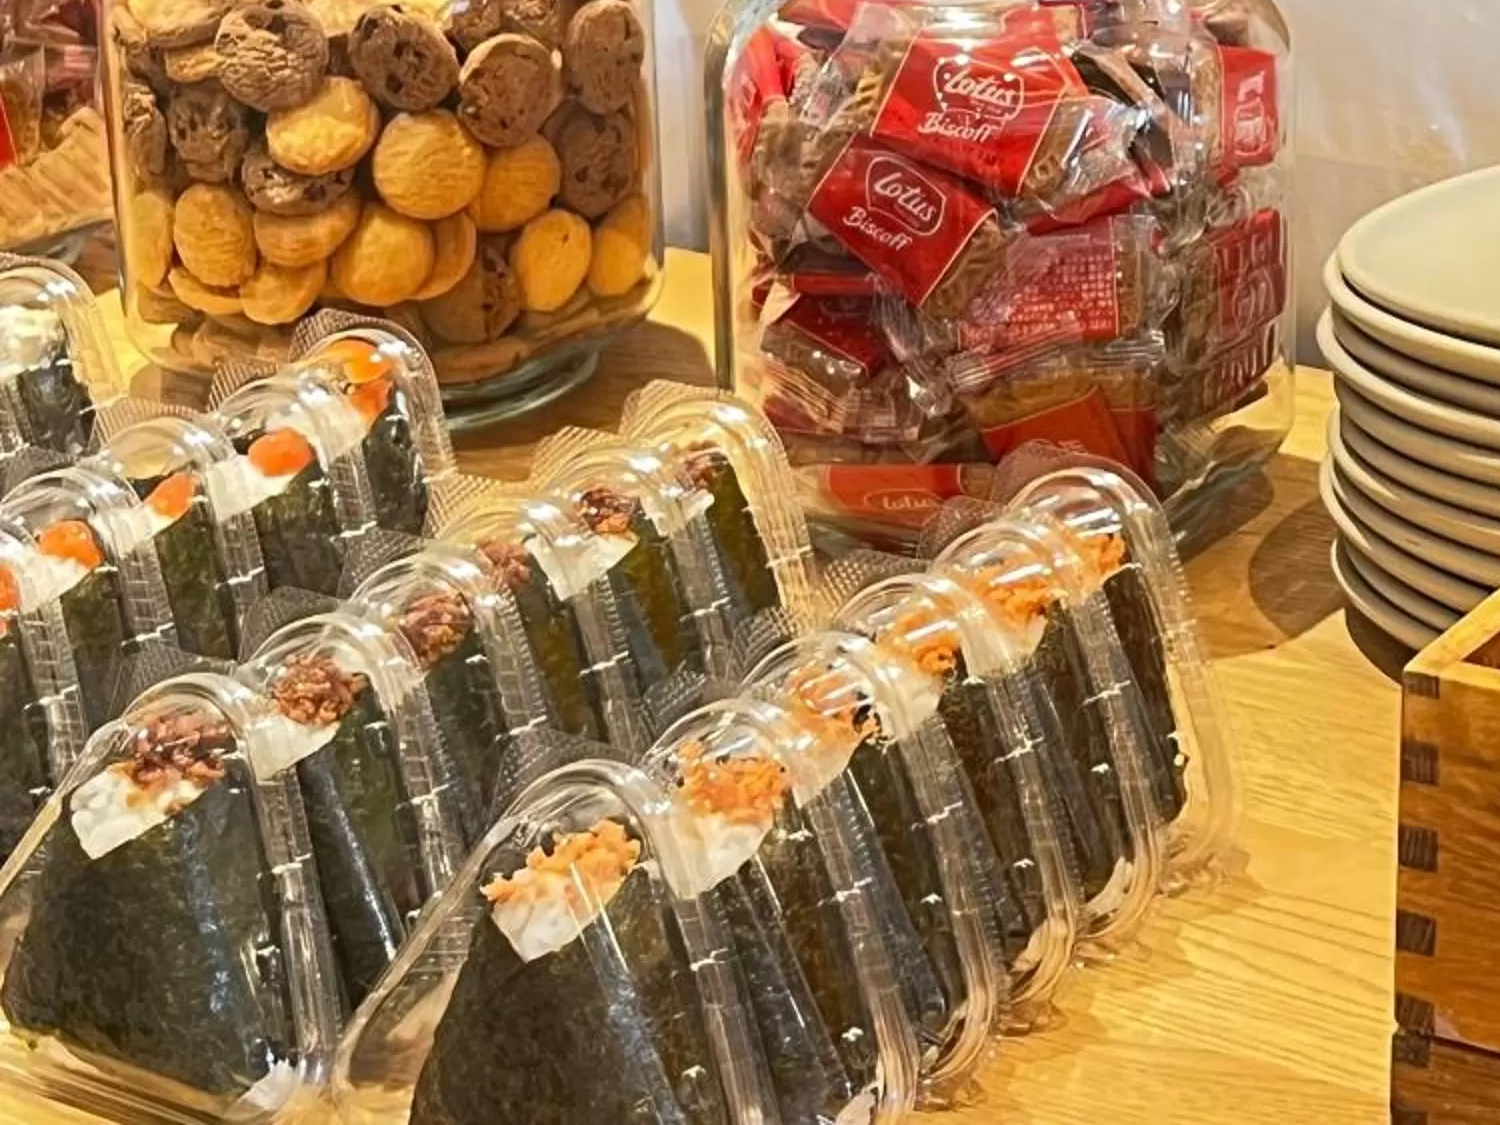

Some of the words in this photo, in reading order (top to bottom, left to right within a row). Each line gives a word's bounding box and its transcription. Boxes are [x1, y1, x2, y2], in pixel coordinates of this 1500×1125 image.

[942, 68, 1017, 108] Lotus
[916, 111, 998, 145] Biscoff
[872, 172, 937, 224] Lotus
[841, 205, 914, 252] Biscoff
